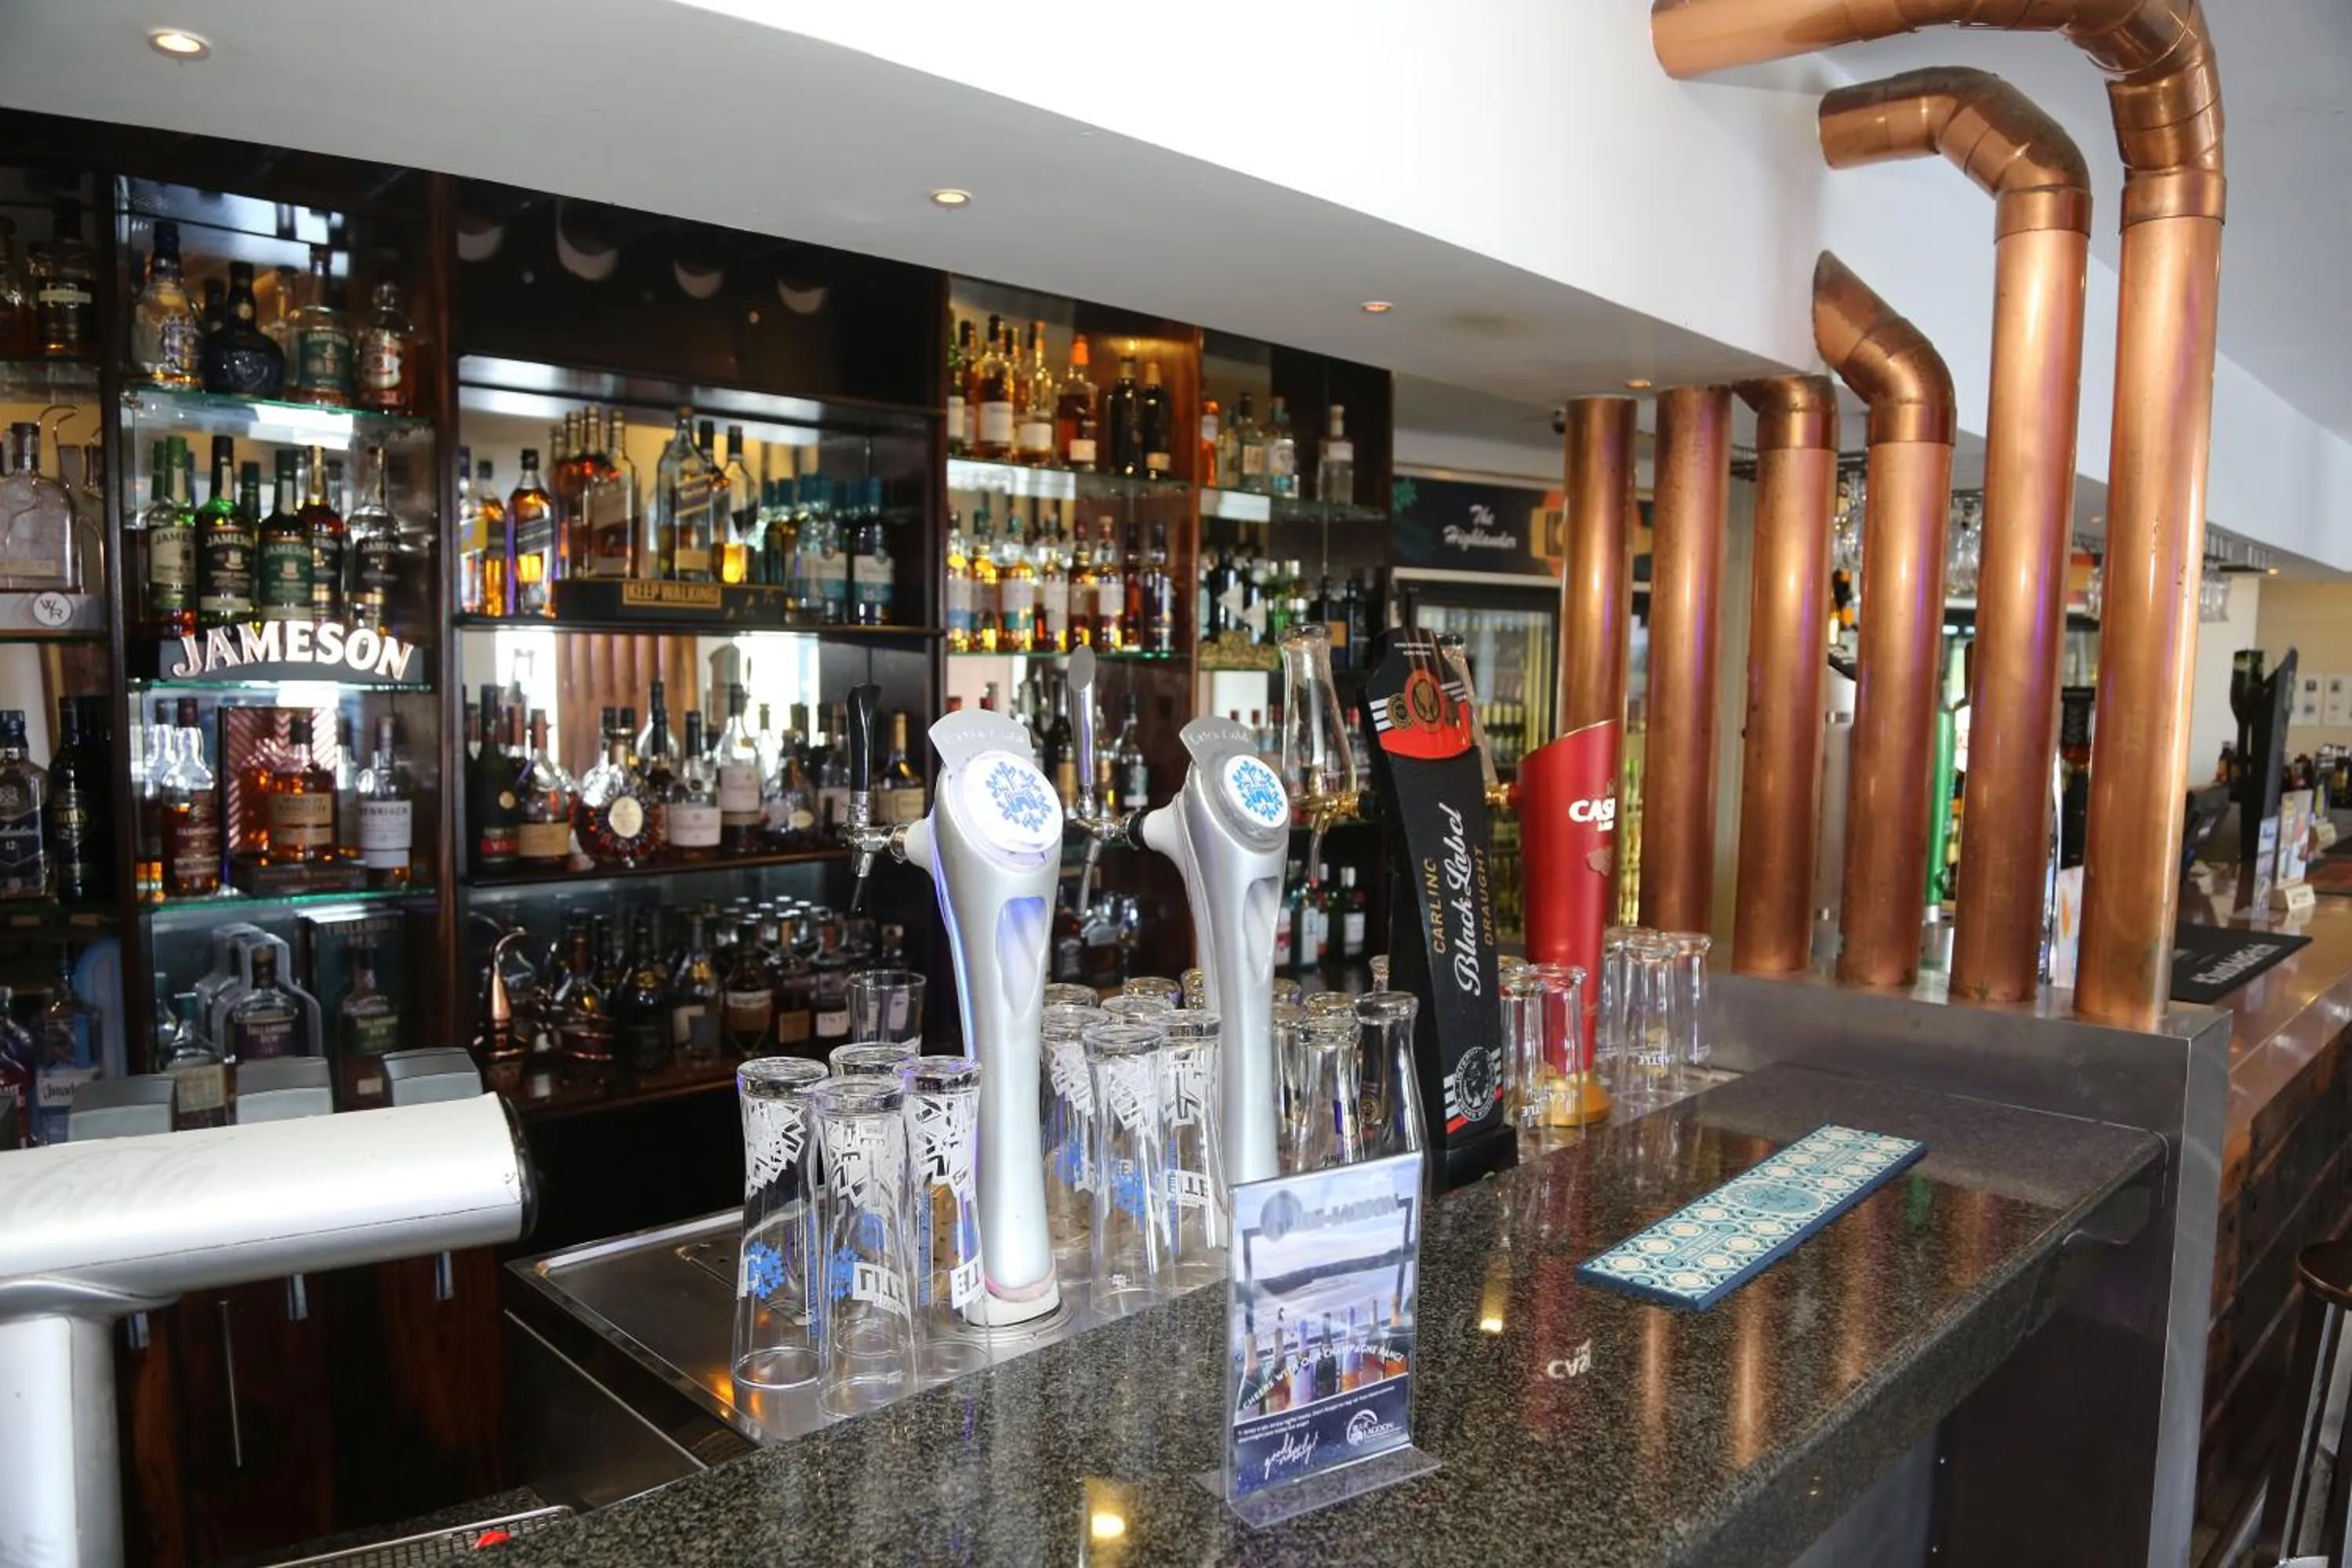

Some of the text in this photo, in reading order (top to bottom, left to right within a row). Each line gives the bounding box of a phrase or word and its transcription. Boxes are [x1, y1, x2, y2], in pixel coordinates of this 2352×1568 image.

[1443, 524, 1517, 552] Highlander
[1468, 503, 1495, 527] The
[172, 621, 413, 681] JAMESON
[1439, 802, 1481, 997] Black Label
[1474, 844, 1494, 946] DRAUGHT
